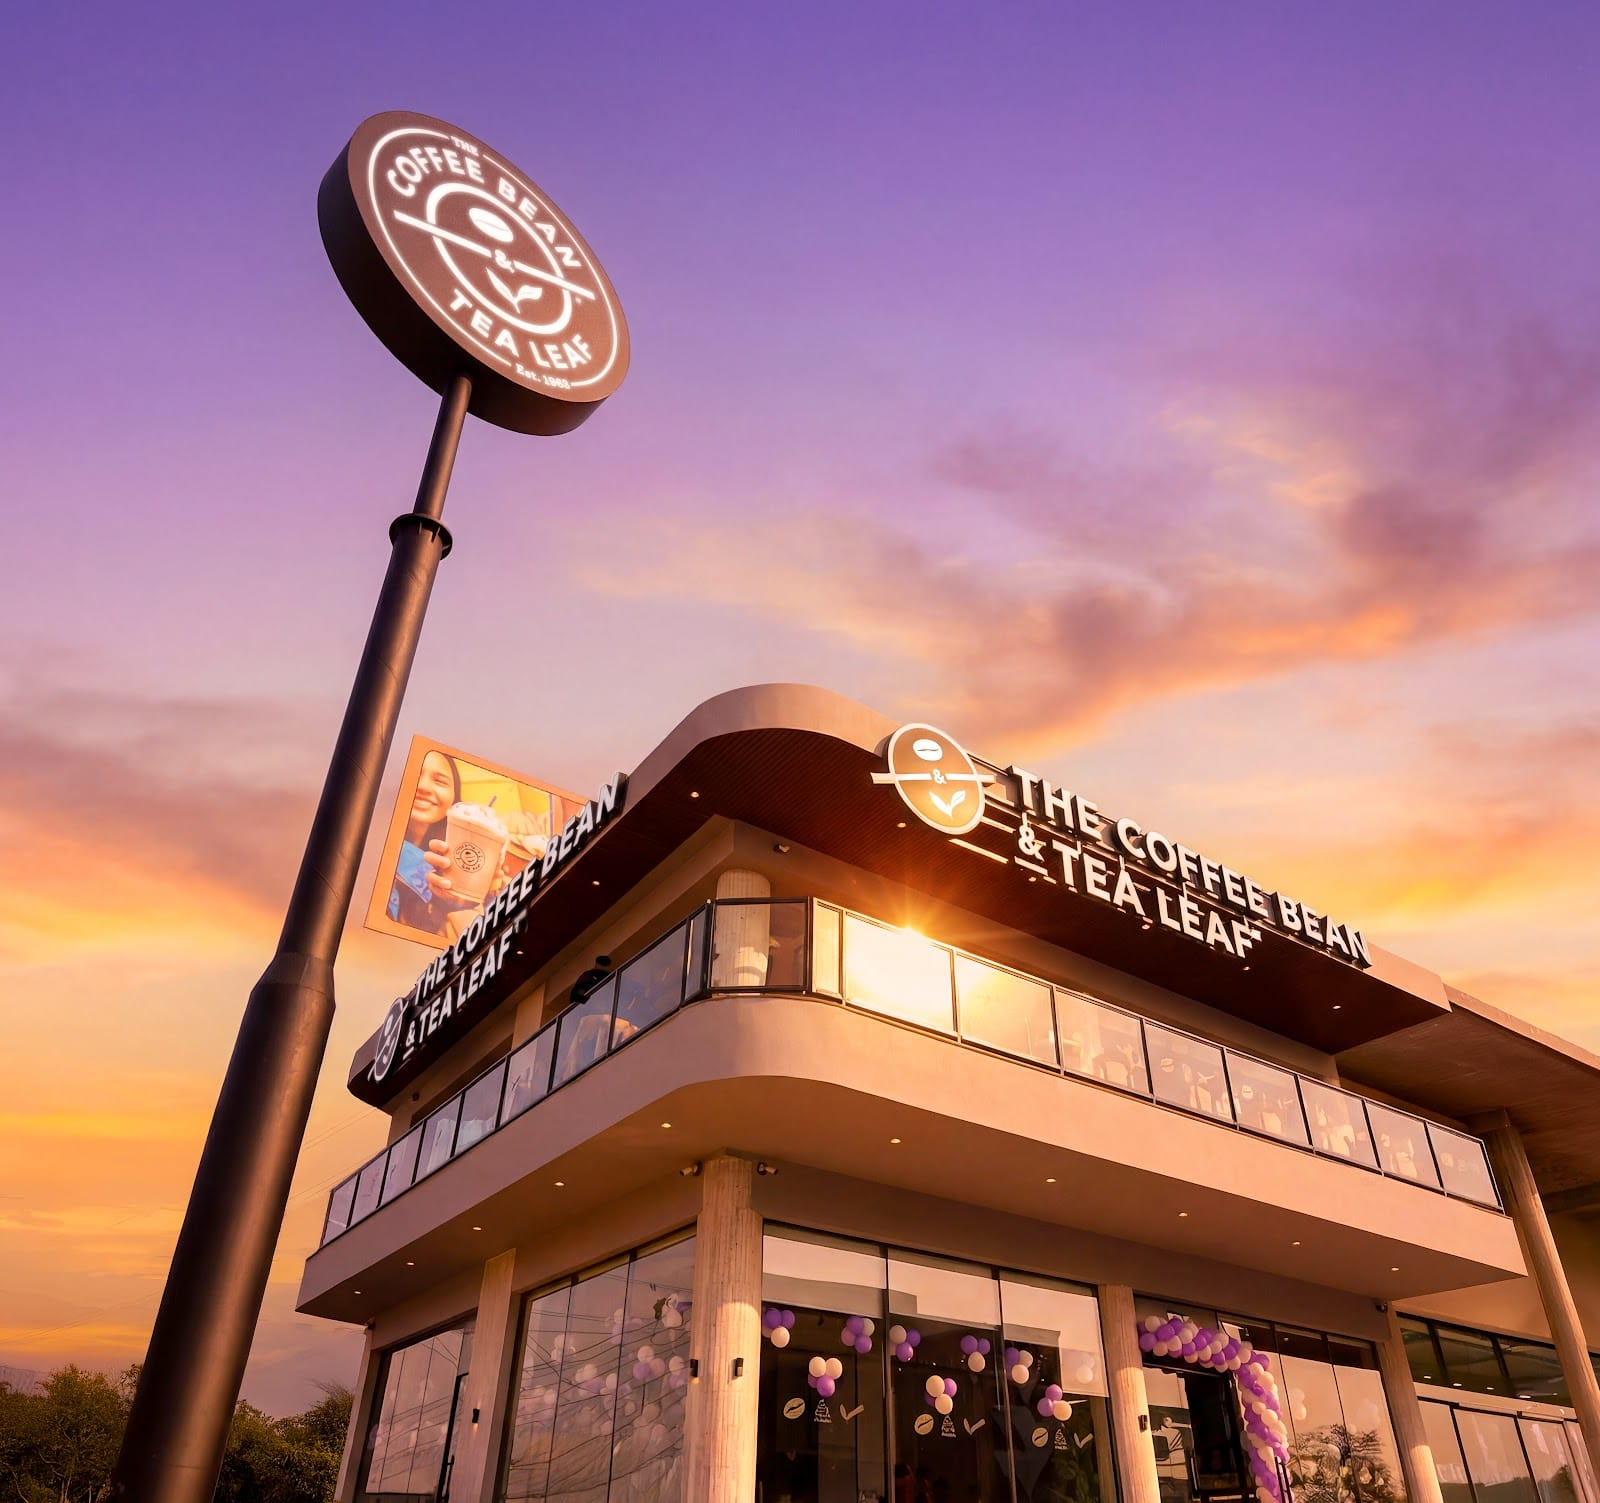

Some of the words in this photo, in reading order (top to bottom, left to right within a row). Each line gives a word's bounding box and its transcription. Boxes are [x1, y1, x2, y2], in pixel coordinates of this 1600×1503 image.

[451, 136, 479, 157] THE
[387, 147, 485, 197] COFFEE
[498, 177, 582, 267] BEAN
[494, 249, 515, 274] &
[450, 288, 519, 358] TEA
[529, 334, 592, 369] LEAF
[515, 363, 541, 382] Est.
[932, 768, 948, 785] &
[414, 953, 449, 1006] THE
[452, 856, 538, 965] COFFEE
[540, 772, 625, 879] BEAN
[1009, 765, 1102, 842] THE
[1114, 817, 1269, 919] COFFEE
[1276, 891, 1372, 967] BEAN
[1018, 824, 1046, 862] &
[1052, 839, 1146, 917] TEA
[1155, 886, 1255, 959] LEAF
[405, 1020, 416, 1048] &
[418, 986, 452, 1044] TEA
[456, 926, 513, 1009] LEAF
